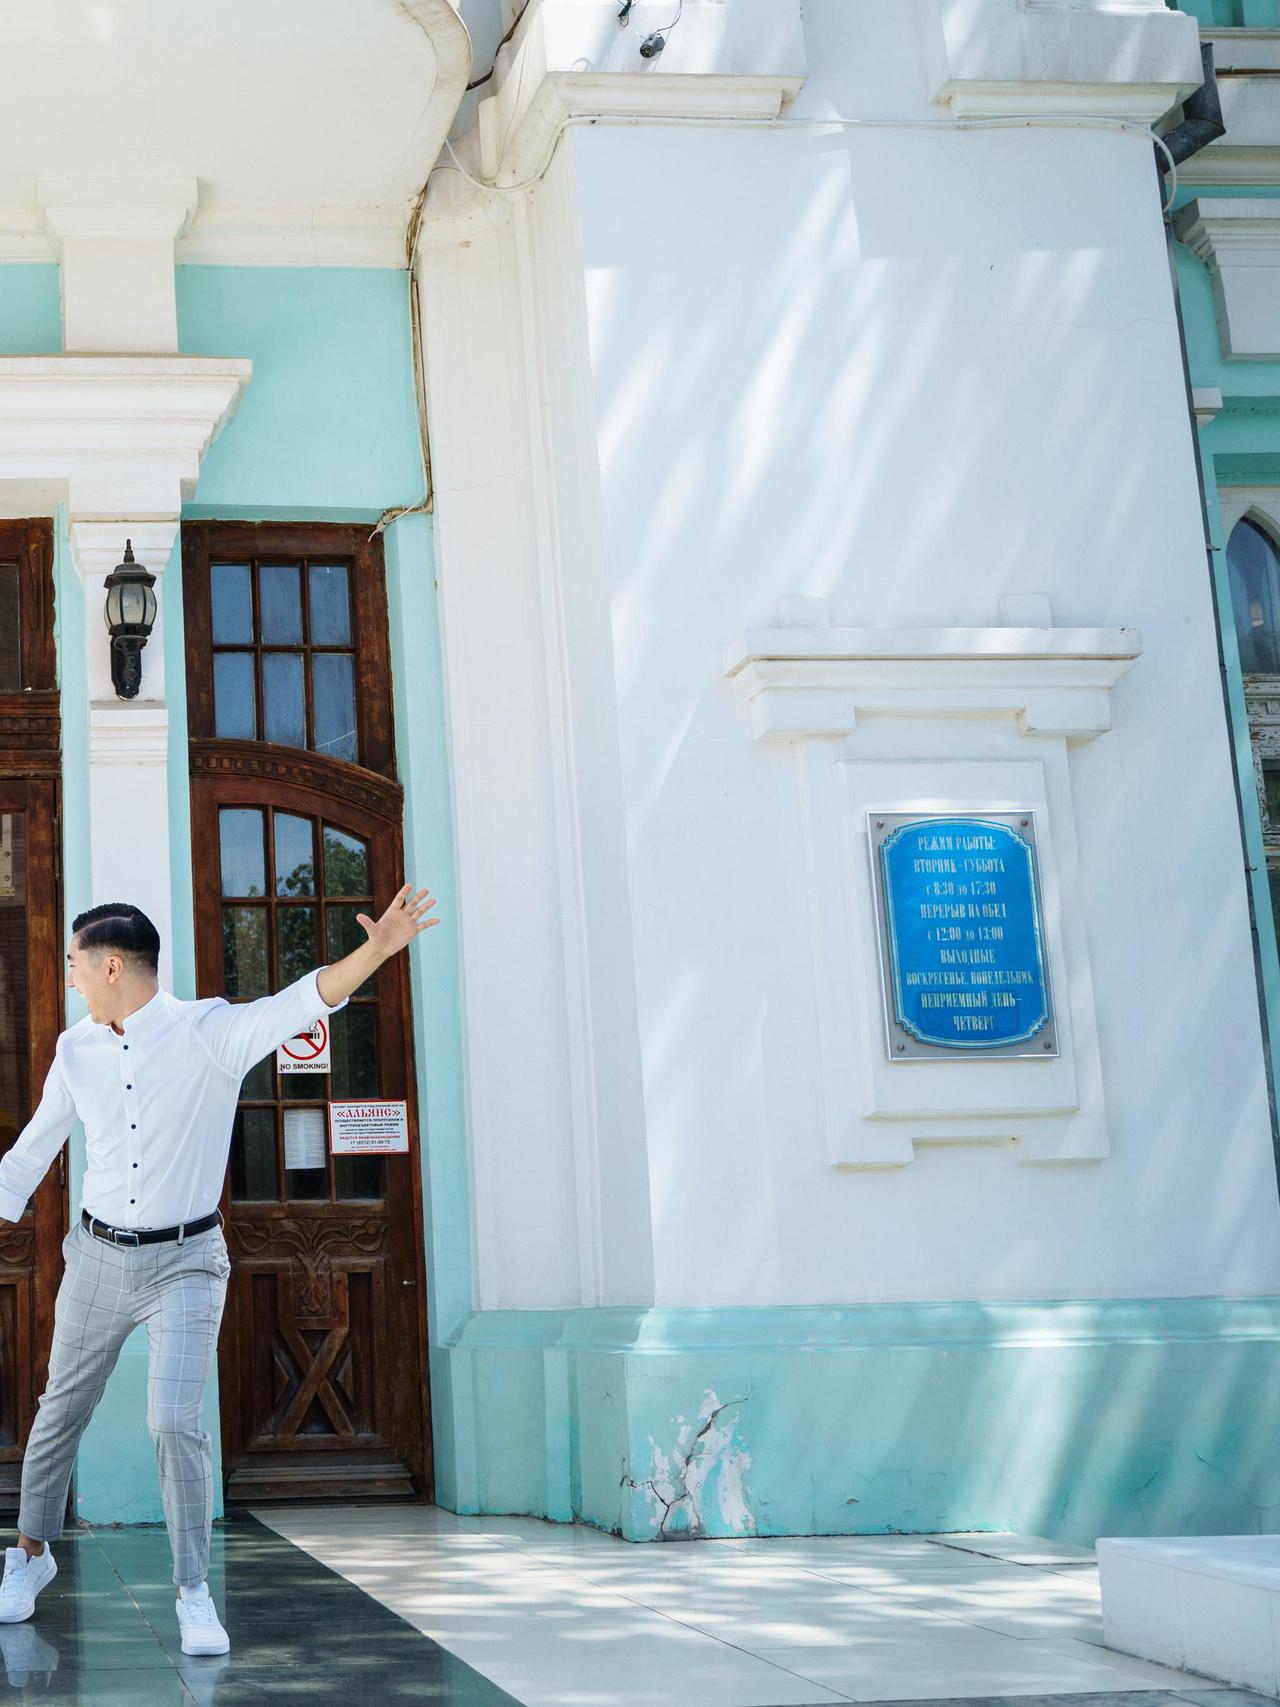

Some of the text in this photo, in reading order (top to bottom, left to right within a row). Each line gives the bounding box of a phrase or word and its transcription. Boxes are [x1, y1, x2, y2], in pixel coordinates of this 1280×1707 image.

[918, 836, 996, 851] РЕЖИМ РАБОТЫ:
[934, 882, 954, 895] 8:30
[957, 885, 967, 896] до
[970, 881, 996, 894] 17:30
[920, 904, 1007, 918] ПЕРЕРЫВ НА ОБЕД
[936, 927, 961, 940] 12:00
[965, 930, 974, 941] до
[978, 927, 1003, 940] 13:00
[941, 949, 995, 965] ВЫХОДНЫЕ
[971, 971, 1033, 985] ПОНЕДЕЛЬНИК
[921, 991, 987, 1008] НЕПРИЕМНЫЙ
[953, 1016, 995, 1030] ЧЕТВЕРГ
[337, 1109, 400, 1117] «АЛЬЯНС»
